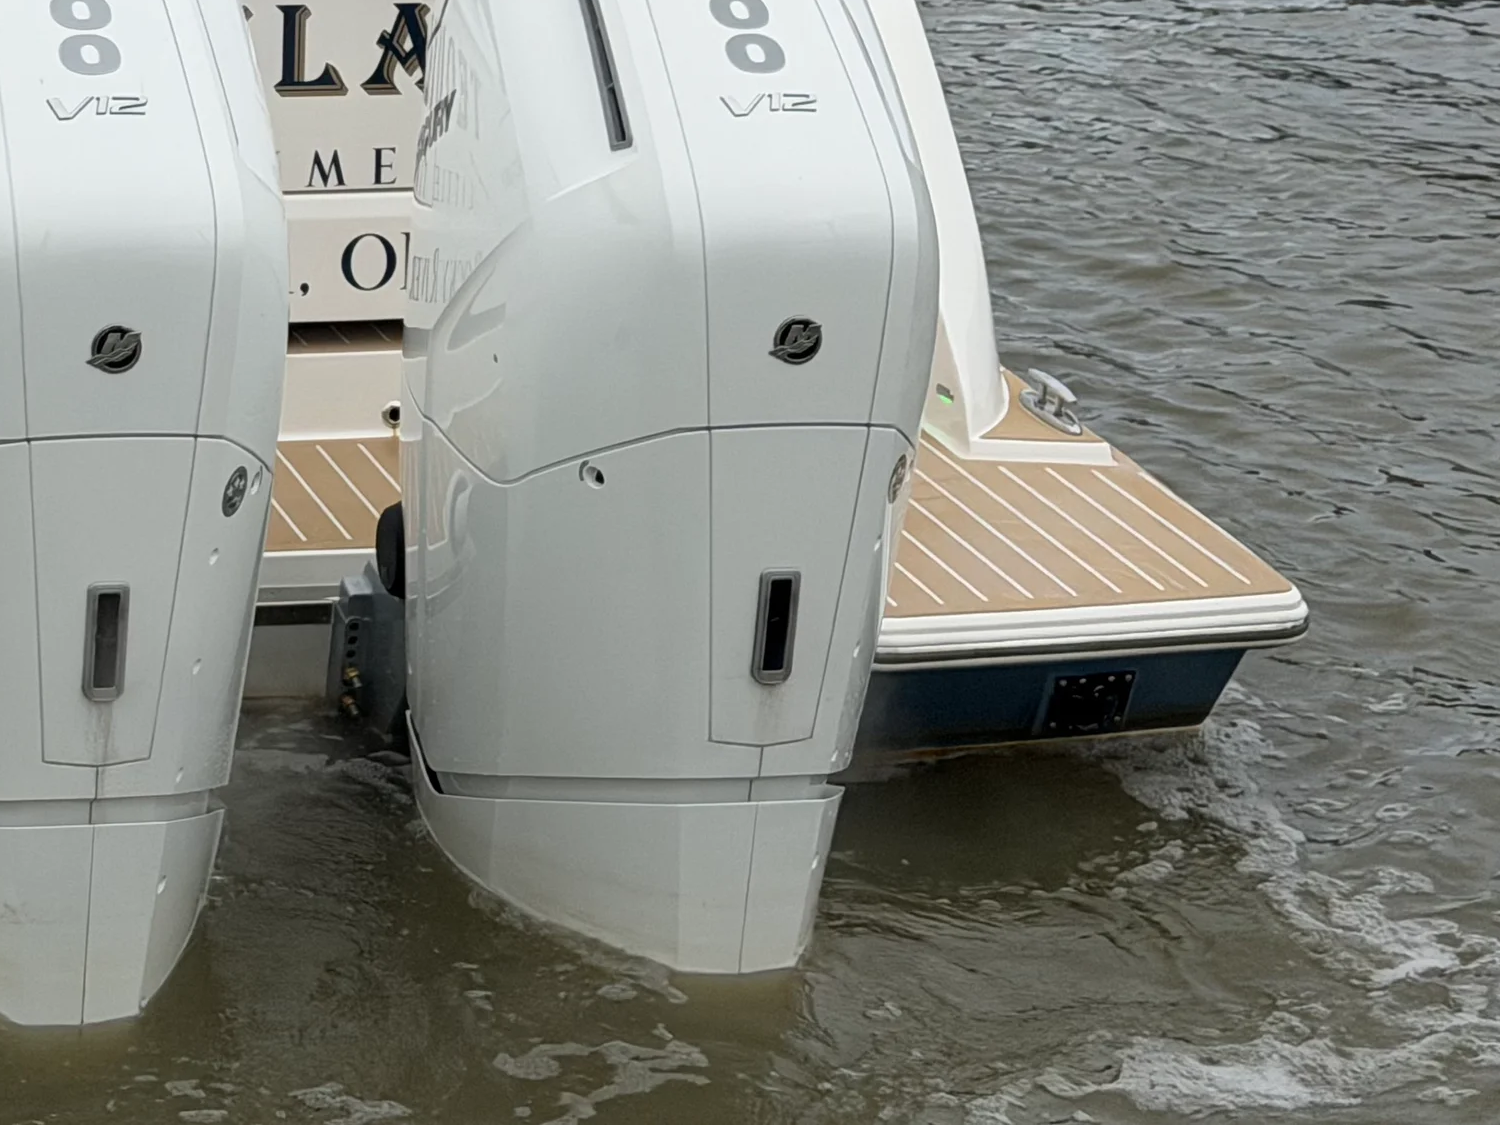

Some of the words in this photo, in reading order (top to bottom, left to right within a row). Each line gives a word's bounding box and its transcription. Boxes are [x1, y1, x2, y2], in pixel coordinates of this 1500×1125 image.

[242, 2, 431, 97] LA
[46, 95, 149, 121] V12
[719, 92, 818, 117] V12
[276, 146, 398, 187] ME
